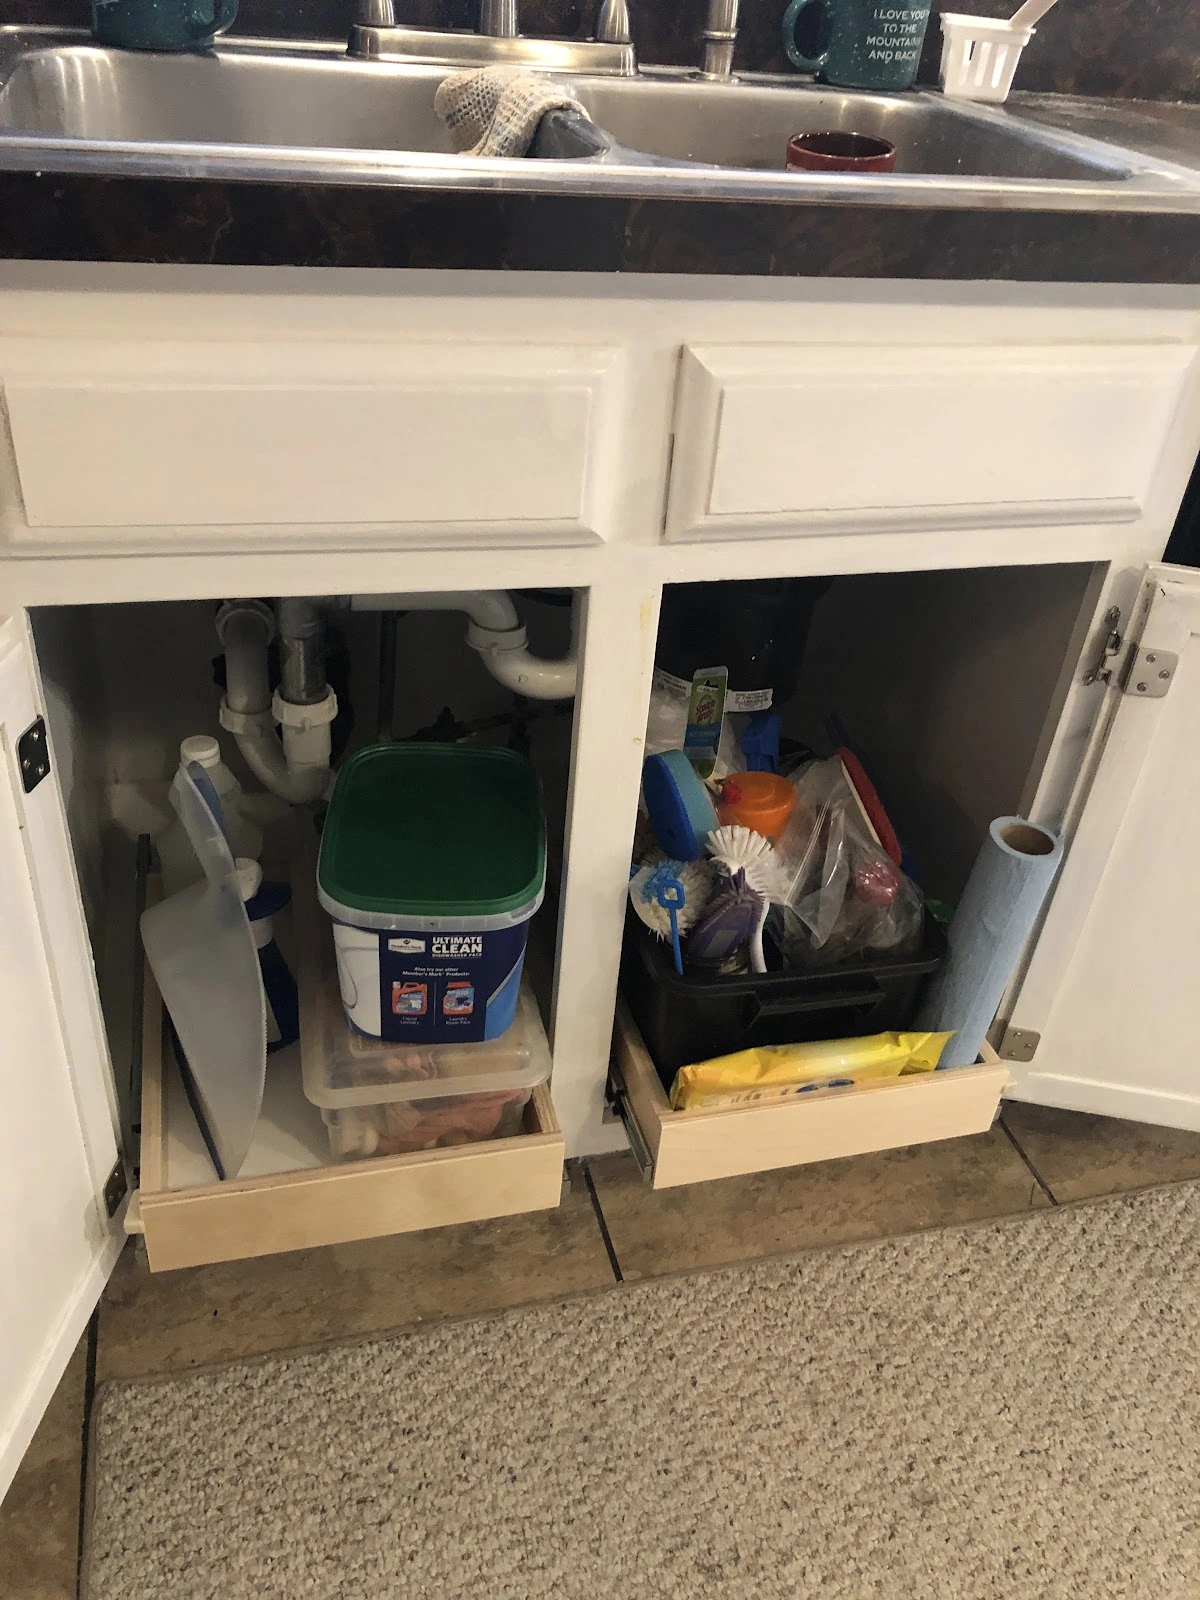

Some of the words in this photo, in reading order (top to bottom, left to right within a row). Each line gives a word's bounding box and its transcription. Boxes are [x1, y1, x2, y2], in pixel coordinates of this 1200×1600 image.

[873, 9, 878, 19] I
[879, 9, 909, 20] LOVE
[910, 10, 926, 21] YOU
[882, 23, 898, 34] TO
[899, 23, 917, 34] THE
[868, 49, 893, 61] AND
[894, 50, 917, 61] BACK
[432, 936, 483, 944] ULTIMATE
[431, 944, 483, 954] CLEAN
